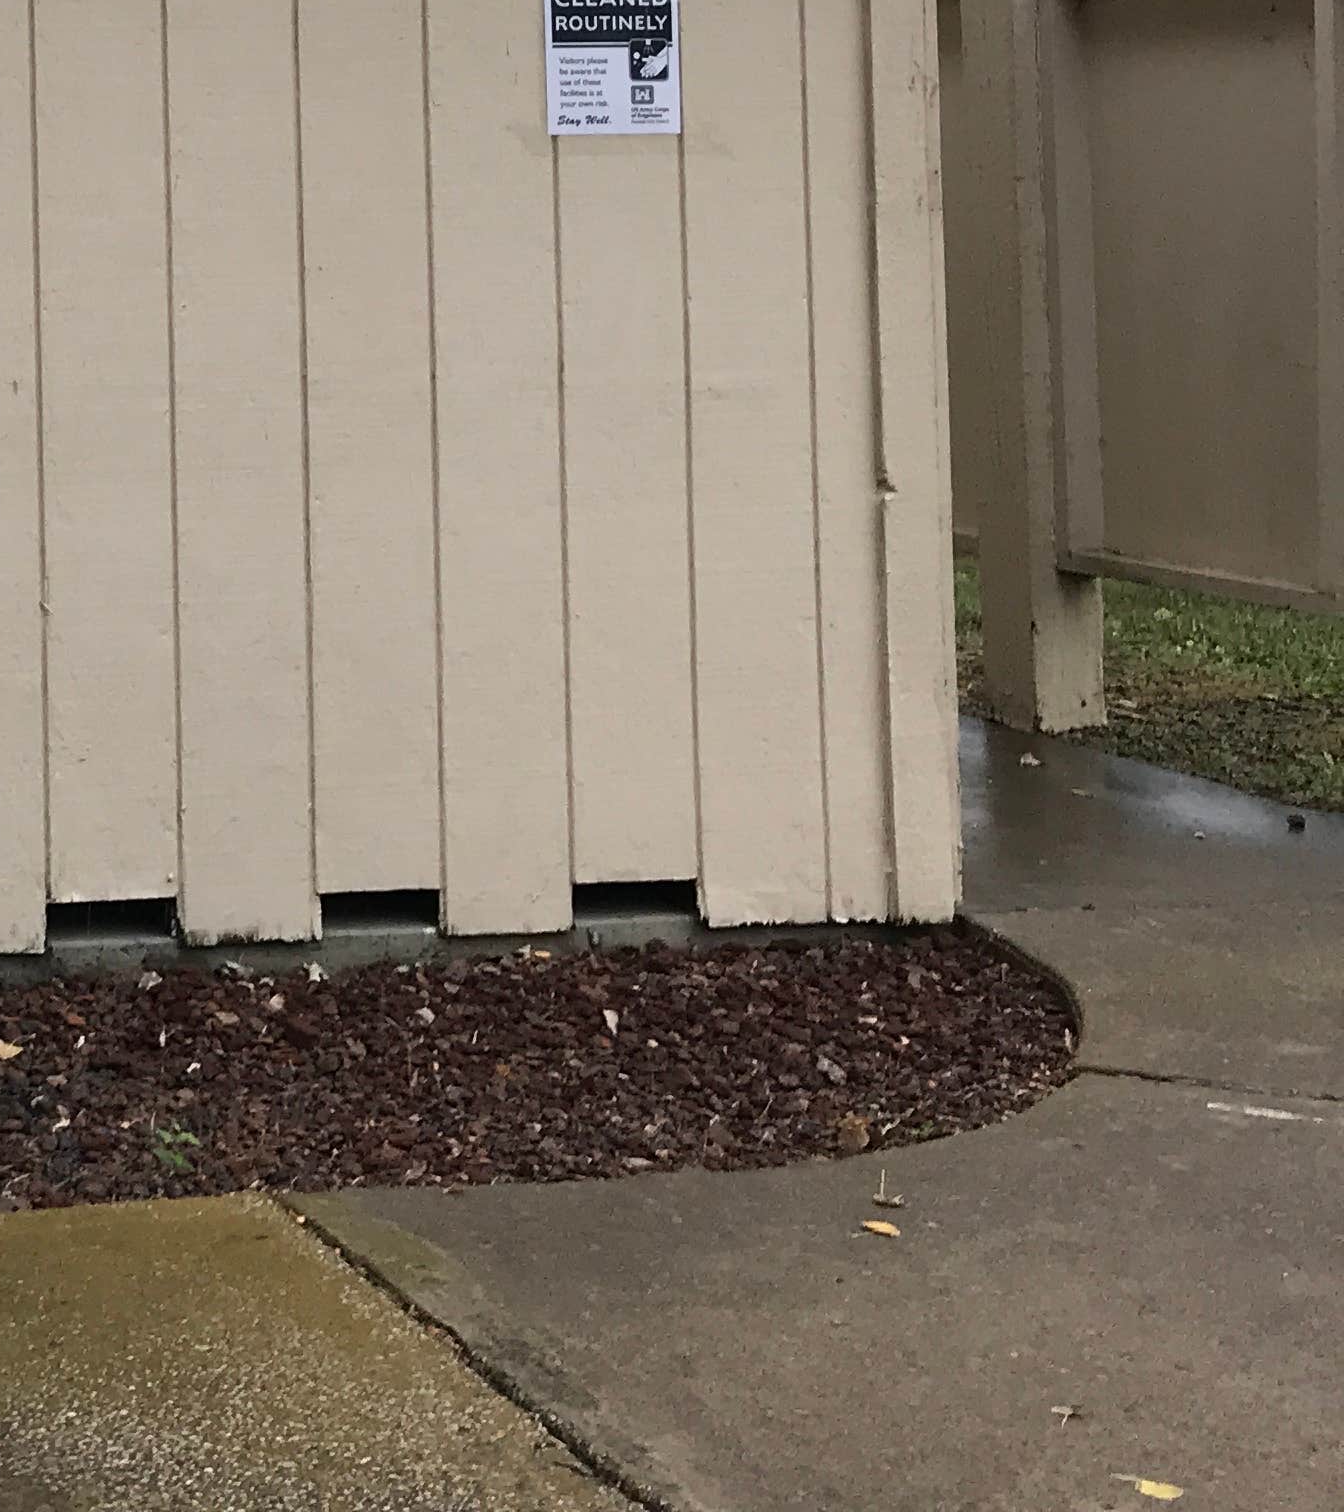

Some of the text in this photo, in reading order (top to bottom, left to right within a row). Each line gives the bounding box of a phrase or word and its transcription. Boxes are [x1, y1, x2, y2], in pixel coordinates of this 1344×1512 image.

[555, 15, 668, 31] ROUTINELY
[587, 57, 608, 65] please
[560, 89, 587, 97] facilities
[560, 101, 576, 109] your
[557, 115, 581, 127] Stay
